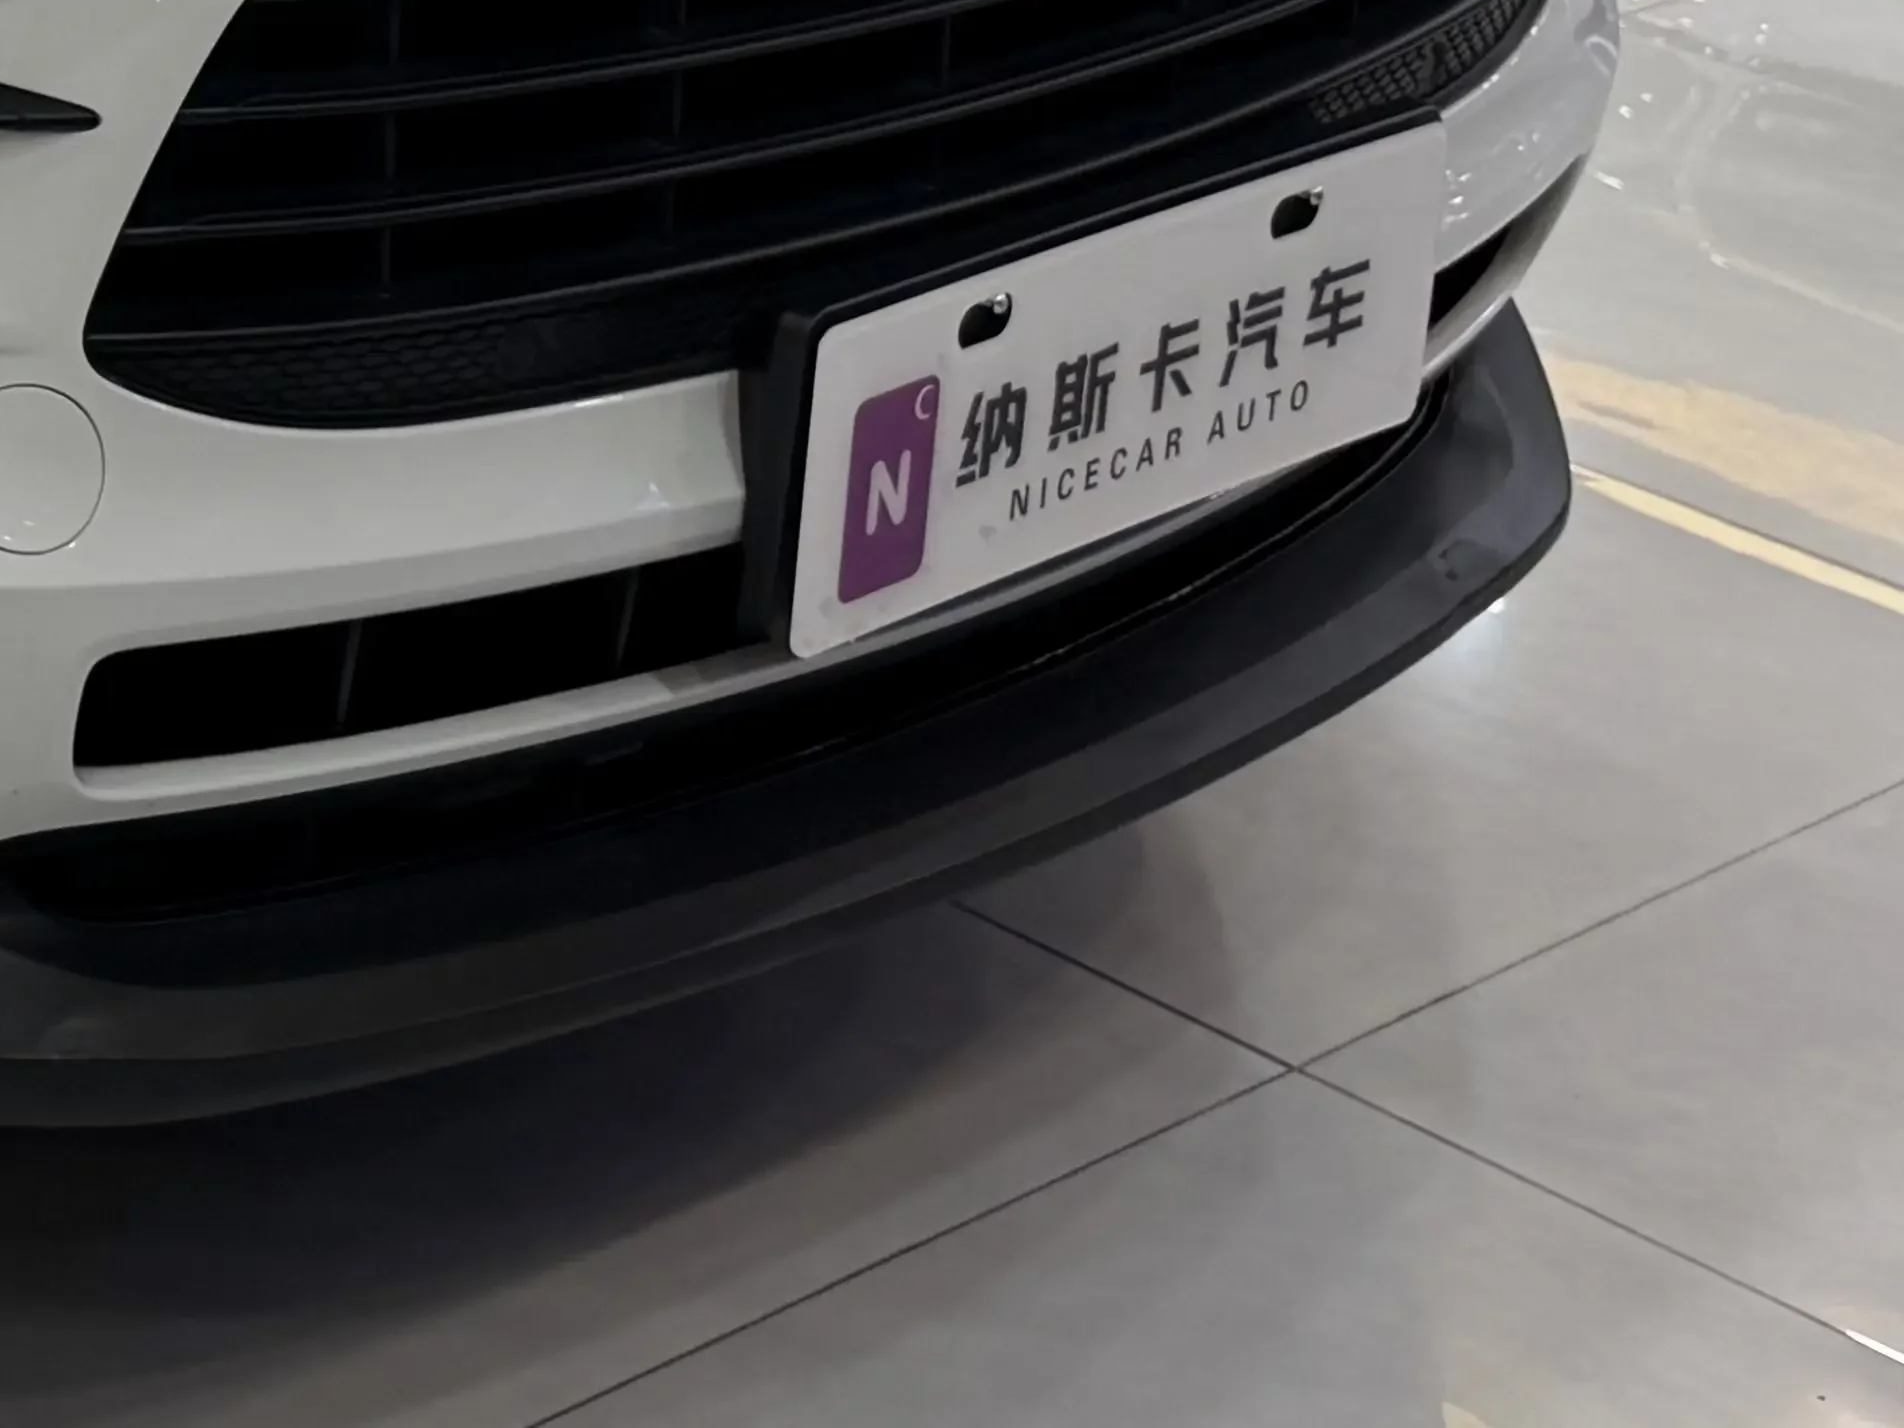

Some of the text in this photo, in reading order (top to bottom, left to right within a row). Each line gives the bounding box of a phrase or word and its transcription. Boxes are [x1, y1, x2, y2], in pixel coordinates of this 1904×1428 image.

[955, 258, 1371, 489] 纳斯卡汽车
[865, 448, 912, 537] N
[1008, 379, 1309, 521] NICECAR AUTO
